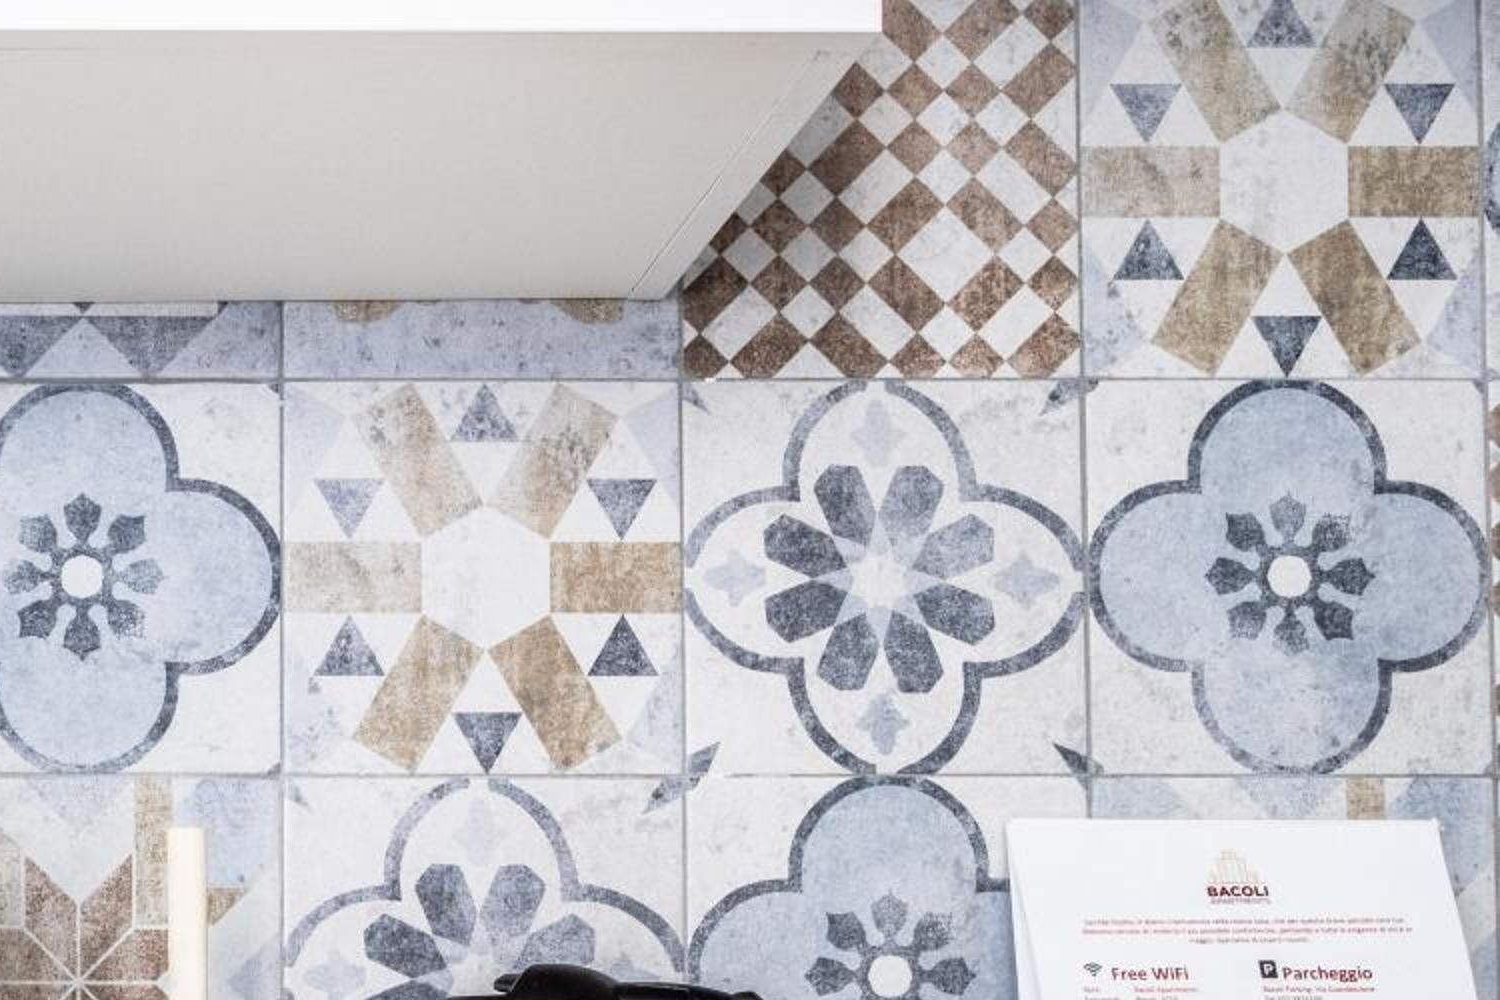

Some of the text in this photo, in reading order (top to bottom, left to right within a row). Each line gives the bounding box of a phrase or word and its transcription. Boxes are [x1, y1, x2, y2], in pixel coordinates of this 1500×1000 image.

[1207, 885, 1269, 897] BACOLI
[1111, 965, 1189, 981] Free WiFi
[1282, 966, 1373, 983] Parcheggio
